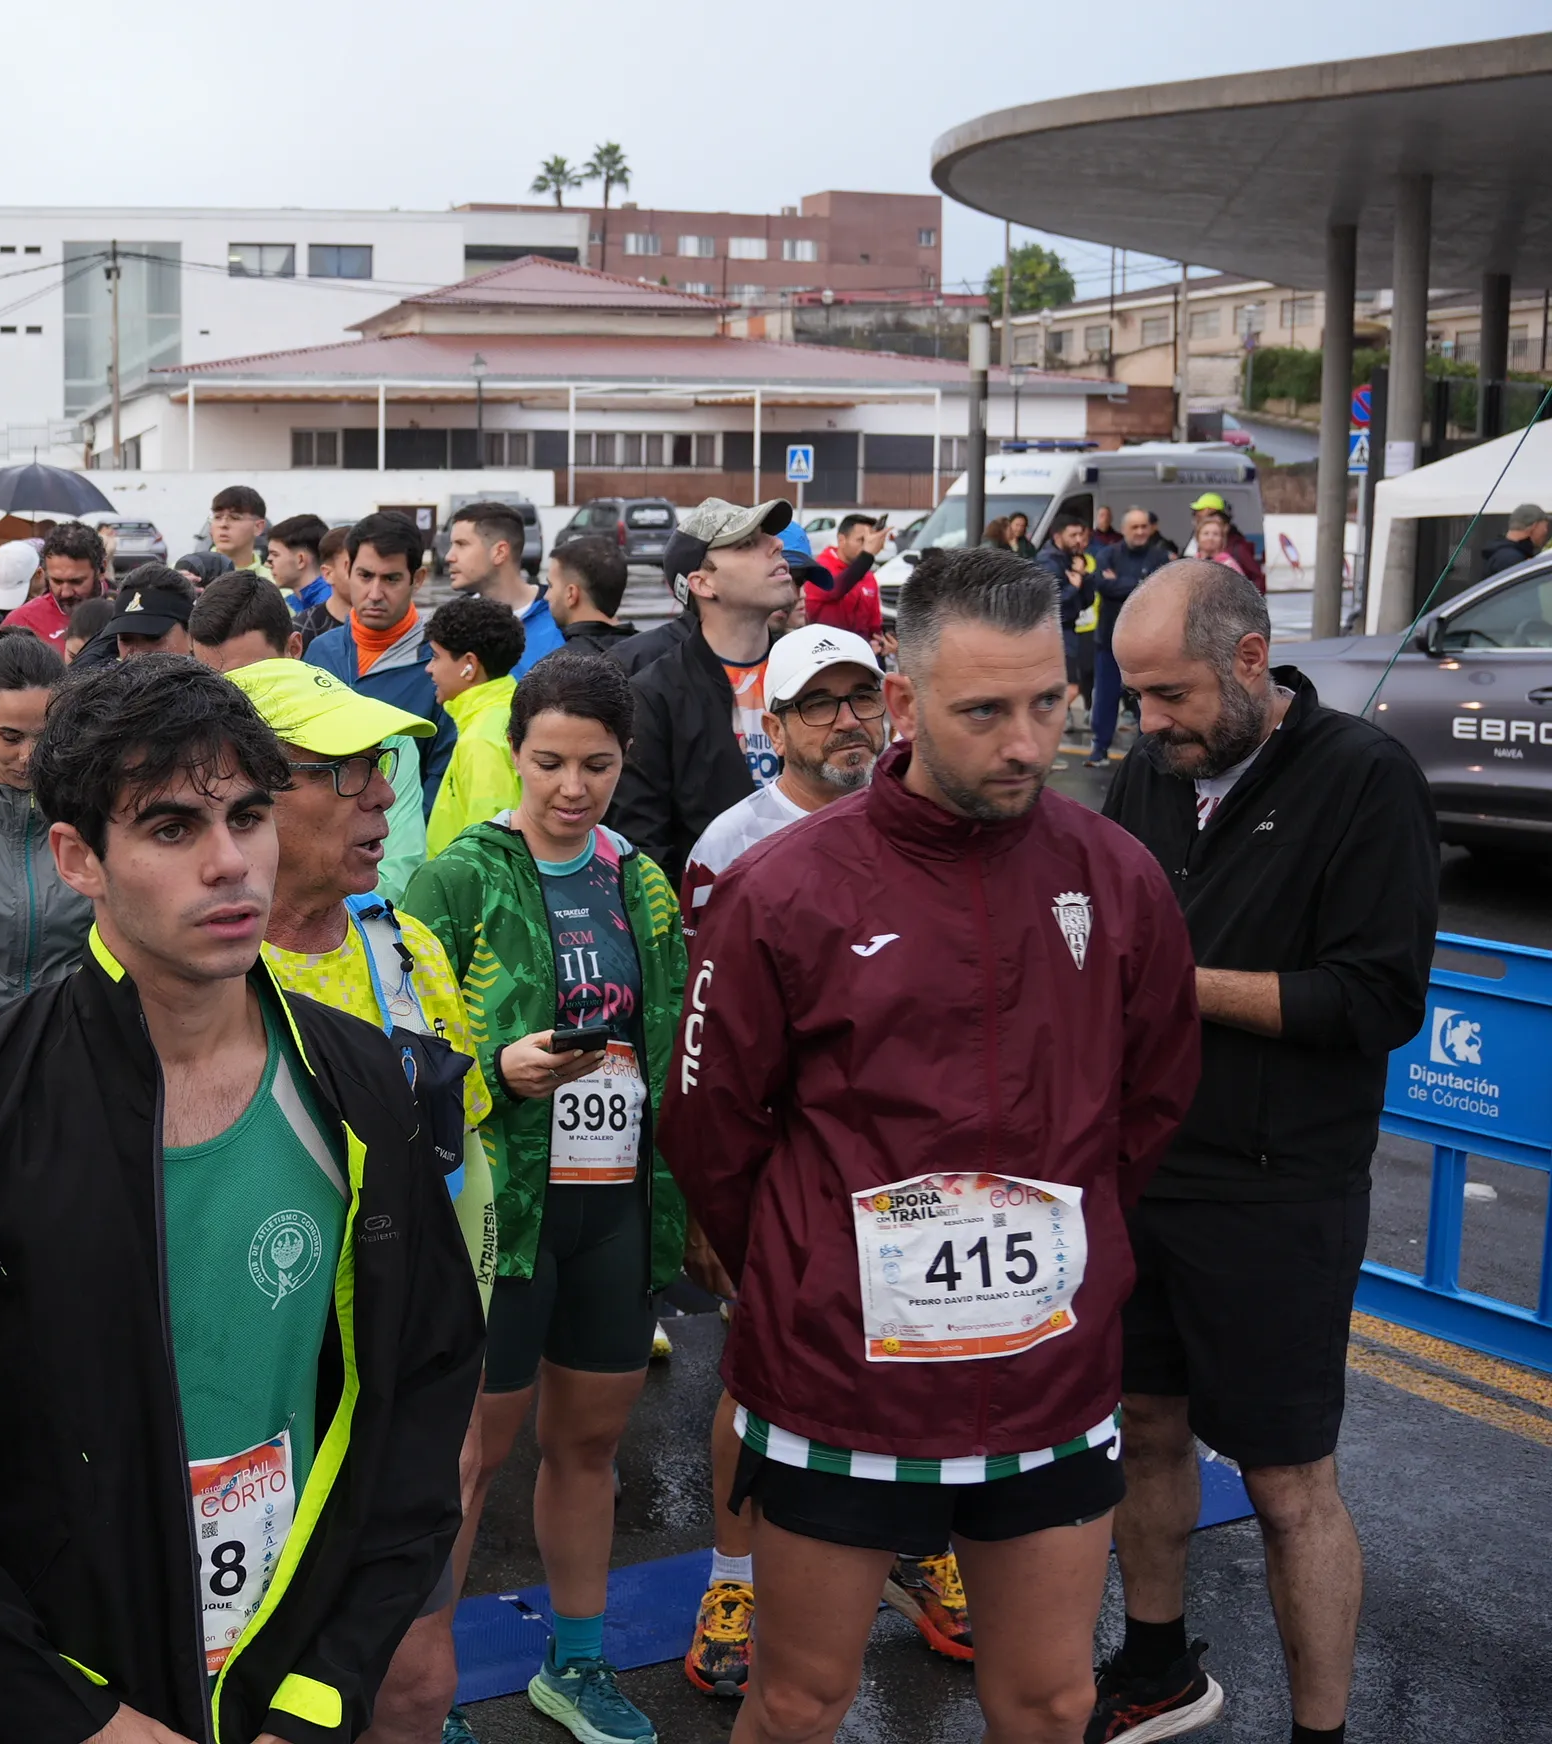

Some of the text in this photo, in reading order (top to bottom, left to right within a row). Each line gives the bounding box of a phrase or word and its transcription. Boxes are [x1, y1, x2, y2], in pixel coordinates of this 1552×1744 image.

[812, 645, 840, 654] adidas
[1494, 747, 1524, 759] NAVEA
[558, 930, 595, 946] CXM
[603, 1061, 639, 1079] CORTO
[1409, 1063, 1500, 1099] Diputación
[558, 1093, 627, 1131] 398
[1408, 1084, 1499, 1118] de Córdoba
[990, 1186, 1044, 1209] COR
[889, 1206, 936, 1223] TRAIL
[943, 1217, 985, 1227] RESULTADOS
[252, 1214, 320, 1284] CLUB DE ATLETISMO CORDOBES
[925, 1231, 1038, 1292] 415
[908, 1286, 1048, 1307] PEDRO DAVID RUANO CALERO
[233, 1459, 274, 1487] TRAIL
[201, 1469, 287, 1518] CORTO
[199, 1540, 247, 1597] 8
